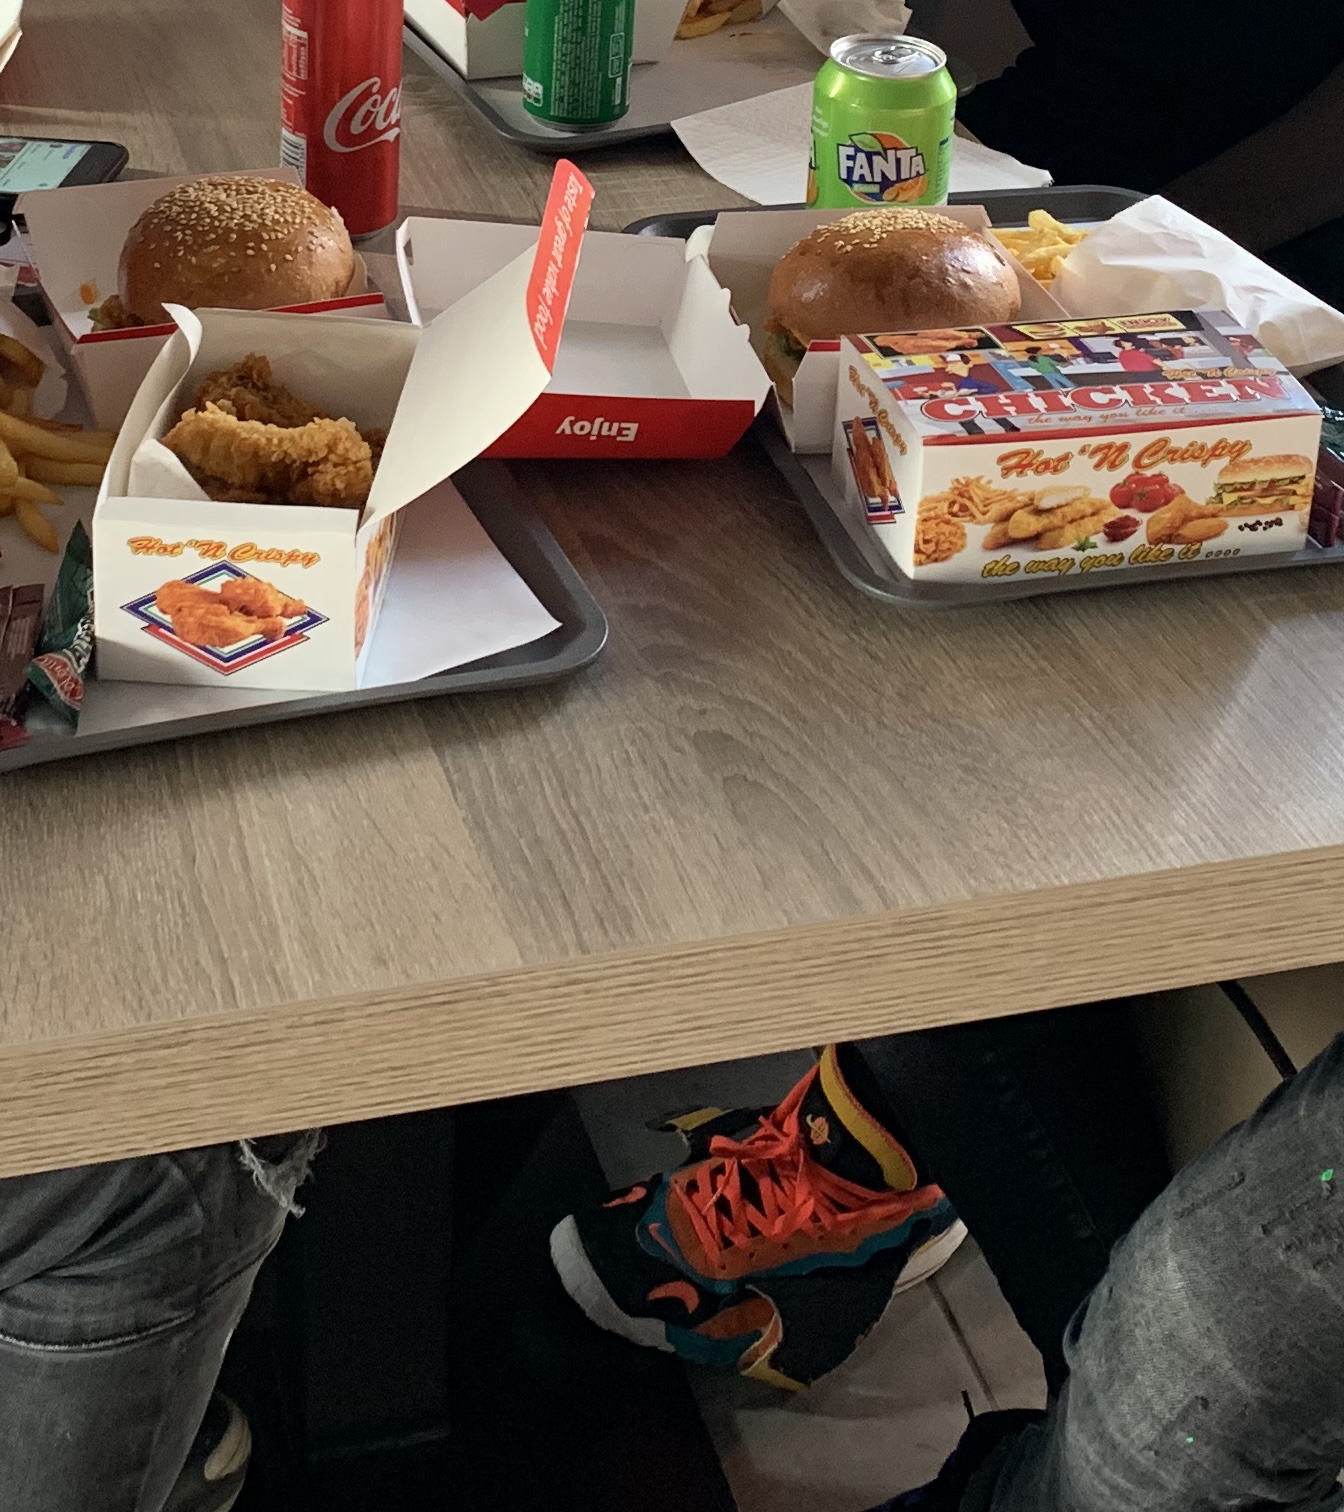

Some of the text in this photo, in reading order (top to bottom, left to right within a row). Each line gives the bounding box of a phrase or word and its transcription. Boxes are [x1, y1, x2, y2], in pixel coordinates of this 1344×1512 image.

[837, 143, 926, 183] FANTA
[564, 172, 584, 212] Taste
[552, 216, 567, 268] great
[534, 295, 553, 350] food
[921, 375, 1292, 422] CHICKEN
[1027, 413, 1052, 425] the
[1058, 414, 1093, 423] way
[1099, 411, 1128, 422] you
[1135, 406, 1165, 417] like
[556, 416, 639, 442] Enjoy
[996, 447, 1074, 479] Hot
[1132, 436, 1252, 472] Crispy
[127, 536, 184, 556] Hot
[227, 541, 321, 569] Crispy
[981, 554, 1021, 579] the
[1024, 555, 1076, 576] way
[1079, 550, 1125, 574] you
[1127, 541, 1175, 566] like
